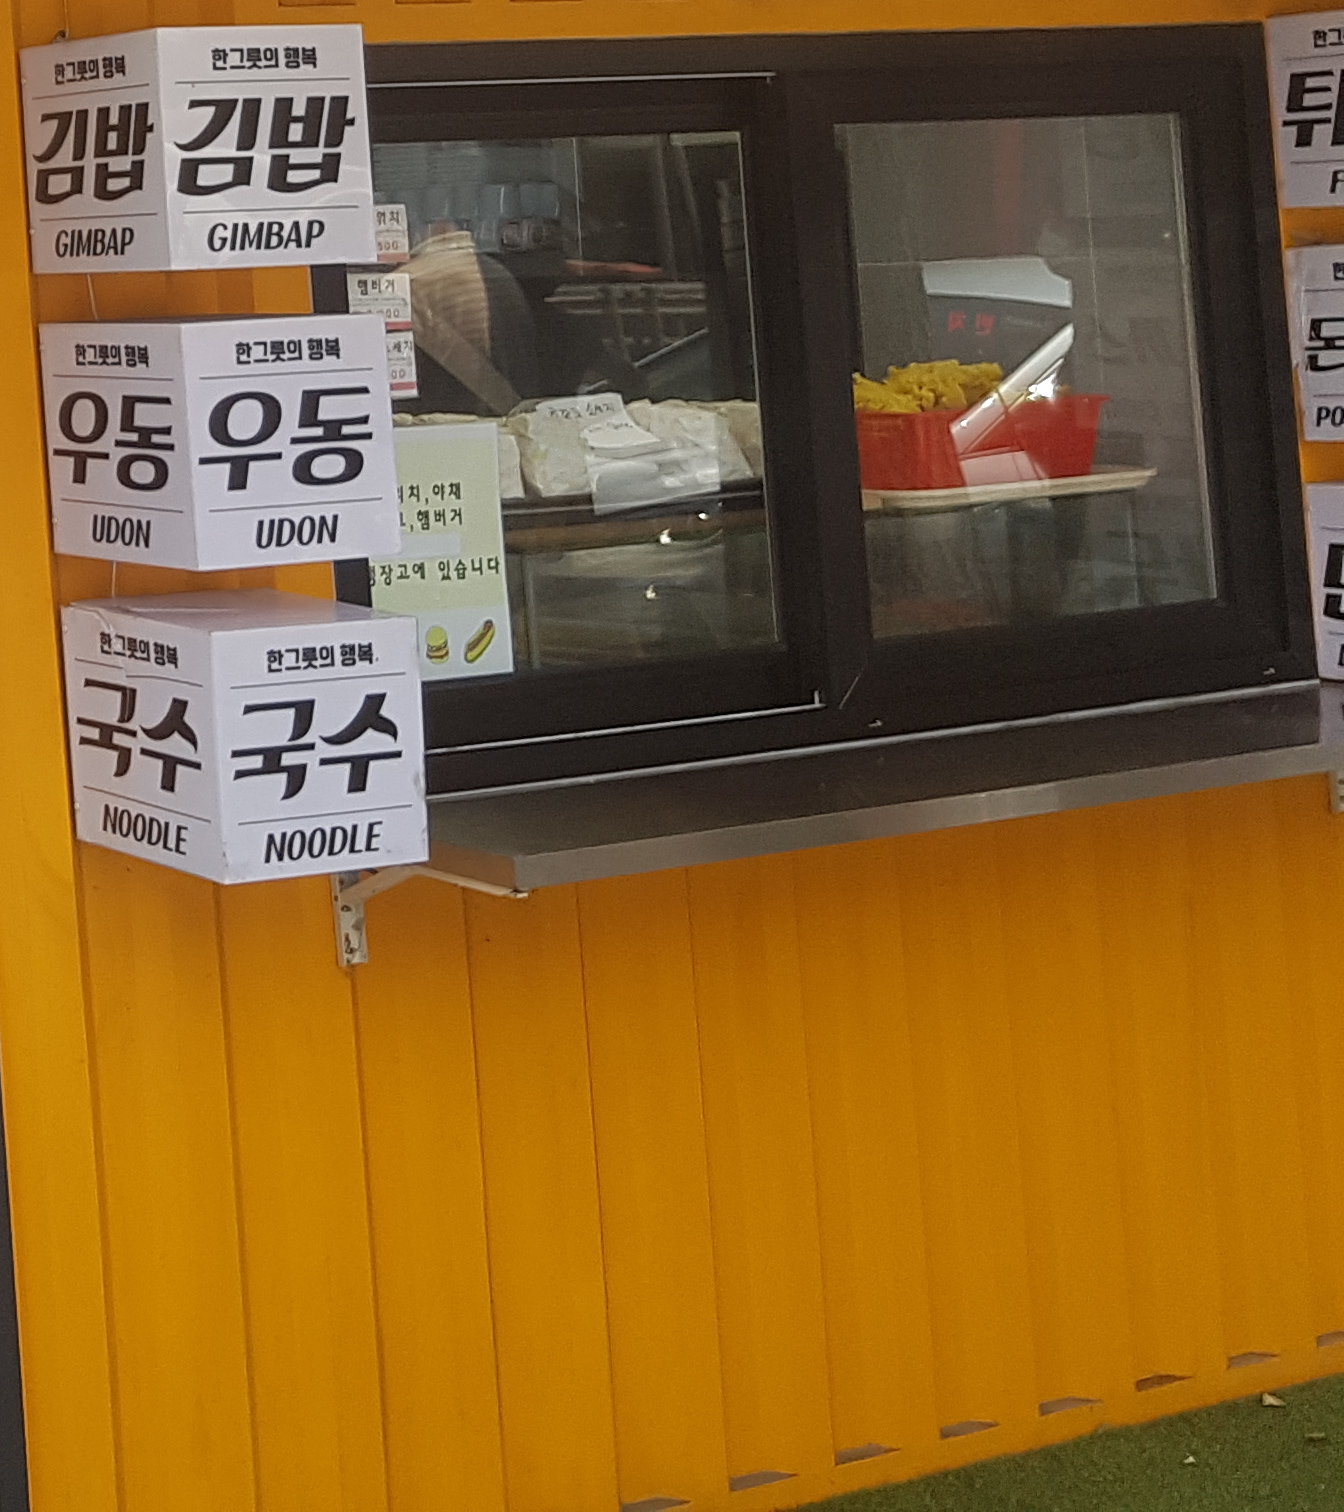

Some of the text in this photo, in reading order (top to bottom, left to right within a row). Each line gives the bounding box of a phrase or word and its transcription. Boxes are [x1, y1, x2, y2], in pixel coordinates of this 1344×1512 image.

[54, 55, 126, 85] 한그릇의 행복
[211, 46, 318, 72] 한그릇의 행복
[33, 101, 154, 204] 김밥
[174, 95, 355, 196] 김밥
[208, 219, 325, 252] GIMBAP
[376, 211, 400, 226] 위치
[55, 226, 134, 258] GIMBAP
[74, 343, 150, 368] 한그릇의 행복
[235, 337, 341, 365] 한그릇의 행복
[52, 390, 175, 491] 우동
[198, 385, 373, 491] 우동
[92, 514, 152, 549] UDON
[255, 514, 339, 549] UDON
[438, 556, 500, 581] 있습니다
[100, 631, 179, 669] 한그릇의 행복
[266, 642, 375, 674] 한그릇의 행복
[76, 678, 202, 793] 국수
[231, 692, 403, 801] 국수
[102, 803, 188, 856] NOODLE
[264, 821, 383, 864] NOODLE
